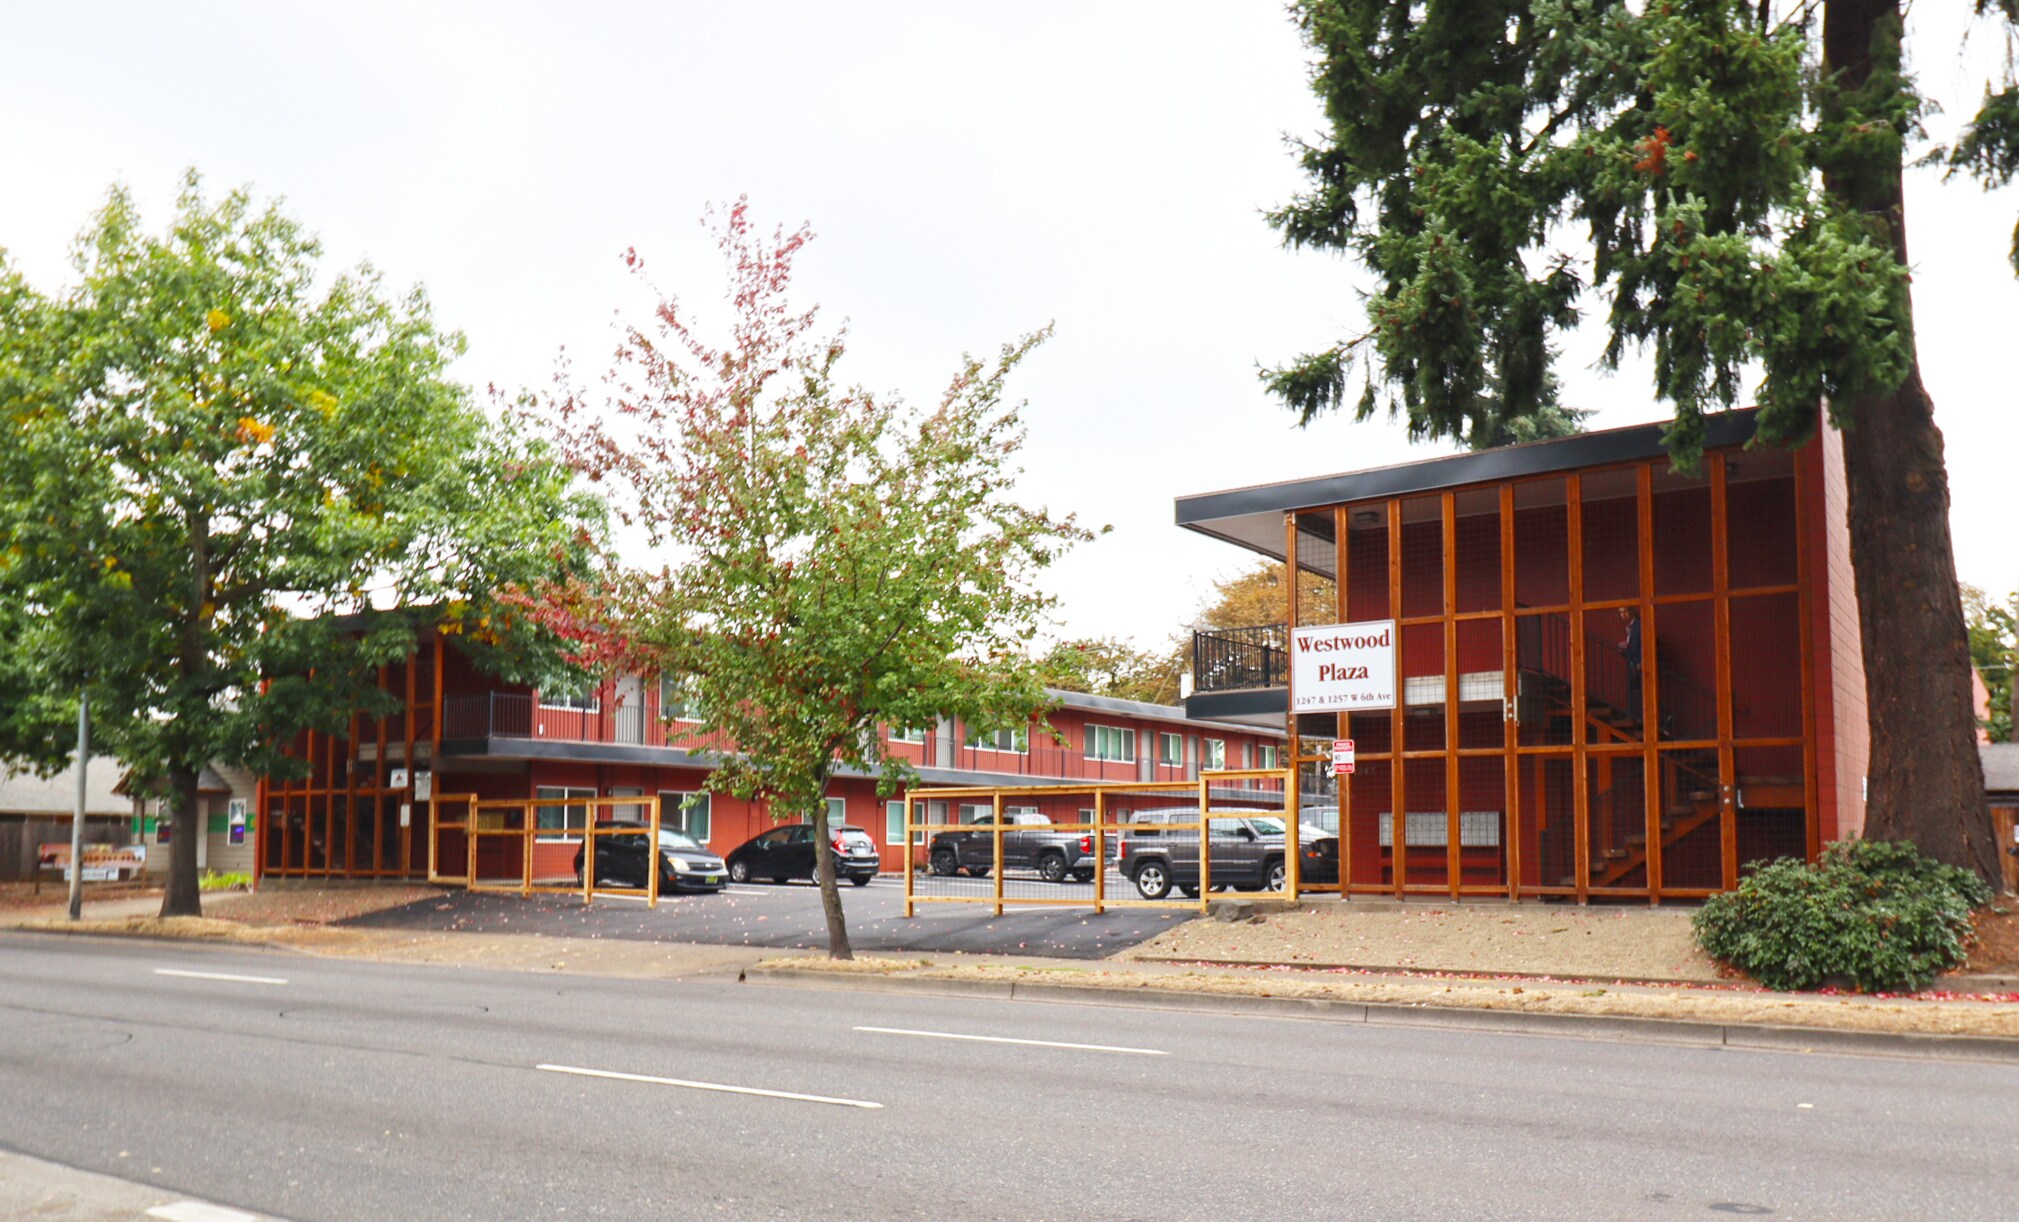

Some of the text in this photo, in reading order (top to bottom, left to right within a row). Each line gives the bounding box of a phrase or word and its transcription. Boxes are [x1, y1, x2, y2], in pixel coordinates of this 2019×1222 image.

[1297, 629, 1390, 653] Westwood
[1318, 663, 1369, 682] Plaza
[1296, 692, 1391, 705] 1247 & 1257 W 6th Ave
